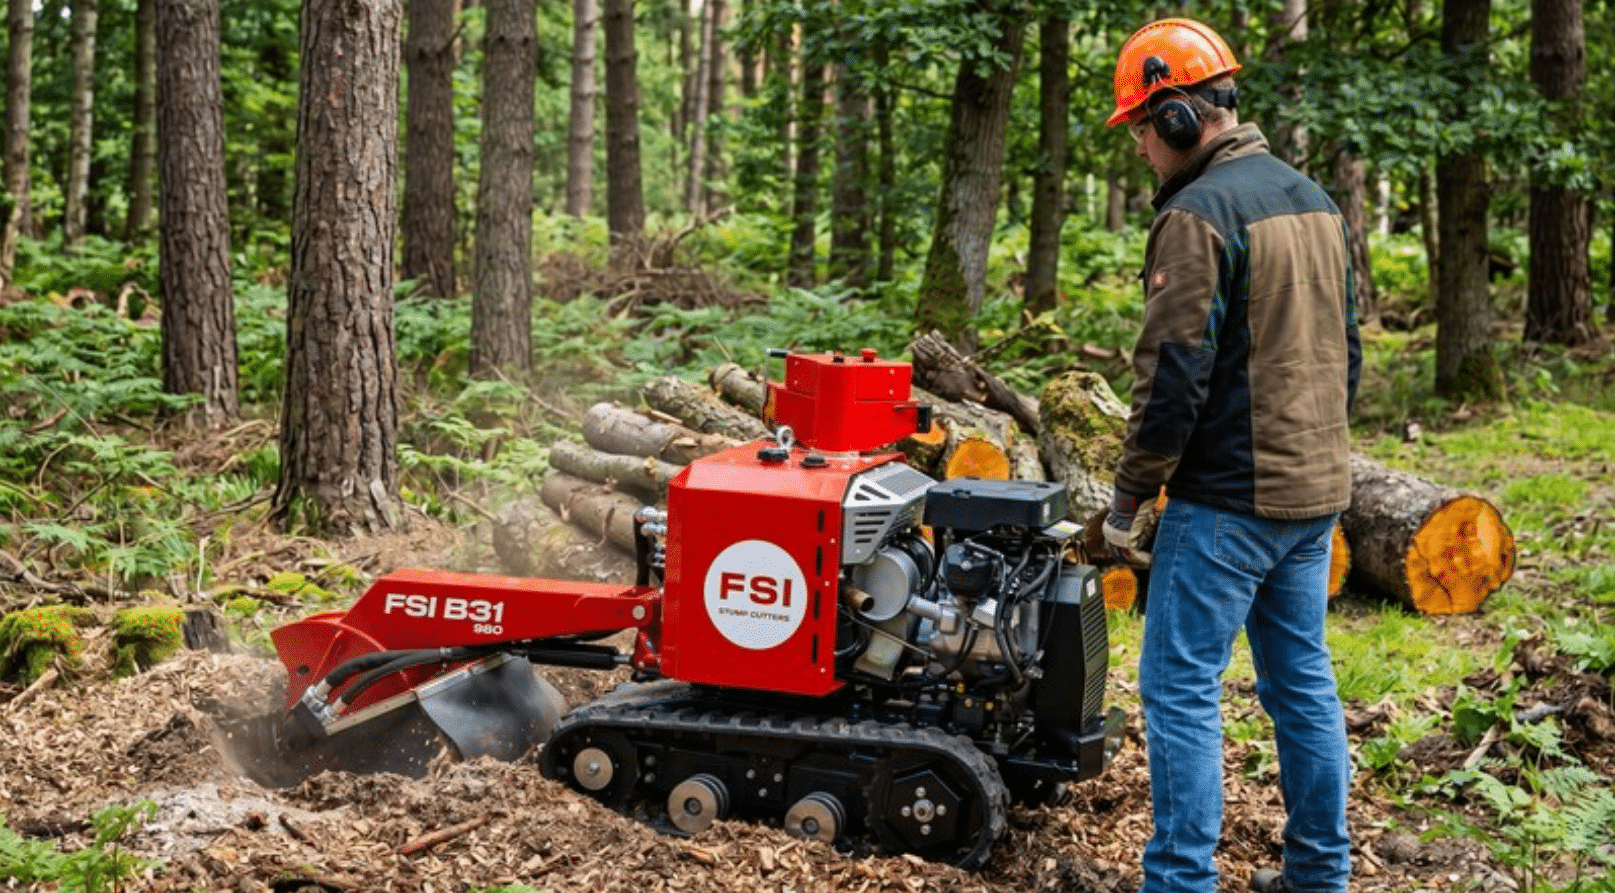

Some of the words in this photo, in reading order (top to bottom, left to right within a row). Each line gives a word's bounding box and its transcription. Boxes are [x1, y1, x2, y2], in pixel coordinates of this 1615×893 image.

[720, 572, 792, 607] FSI
[384, 593, 437, 618] FSI
[443, 597, 504, 623] B31
[718, 607, 749, 617] STUMP
[750, 611, 790, 622] CUTTERS
